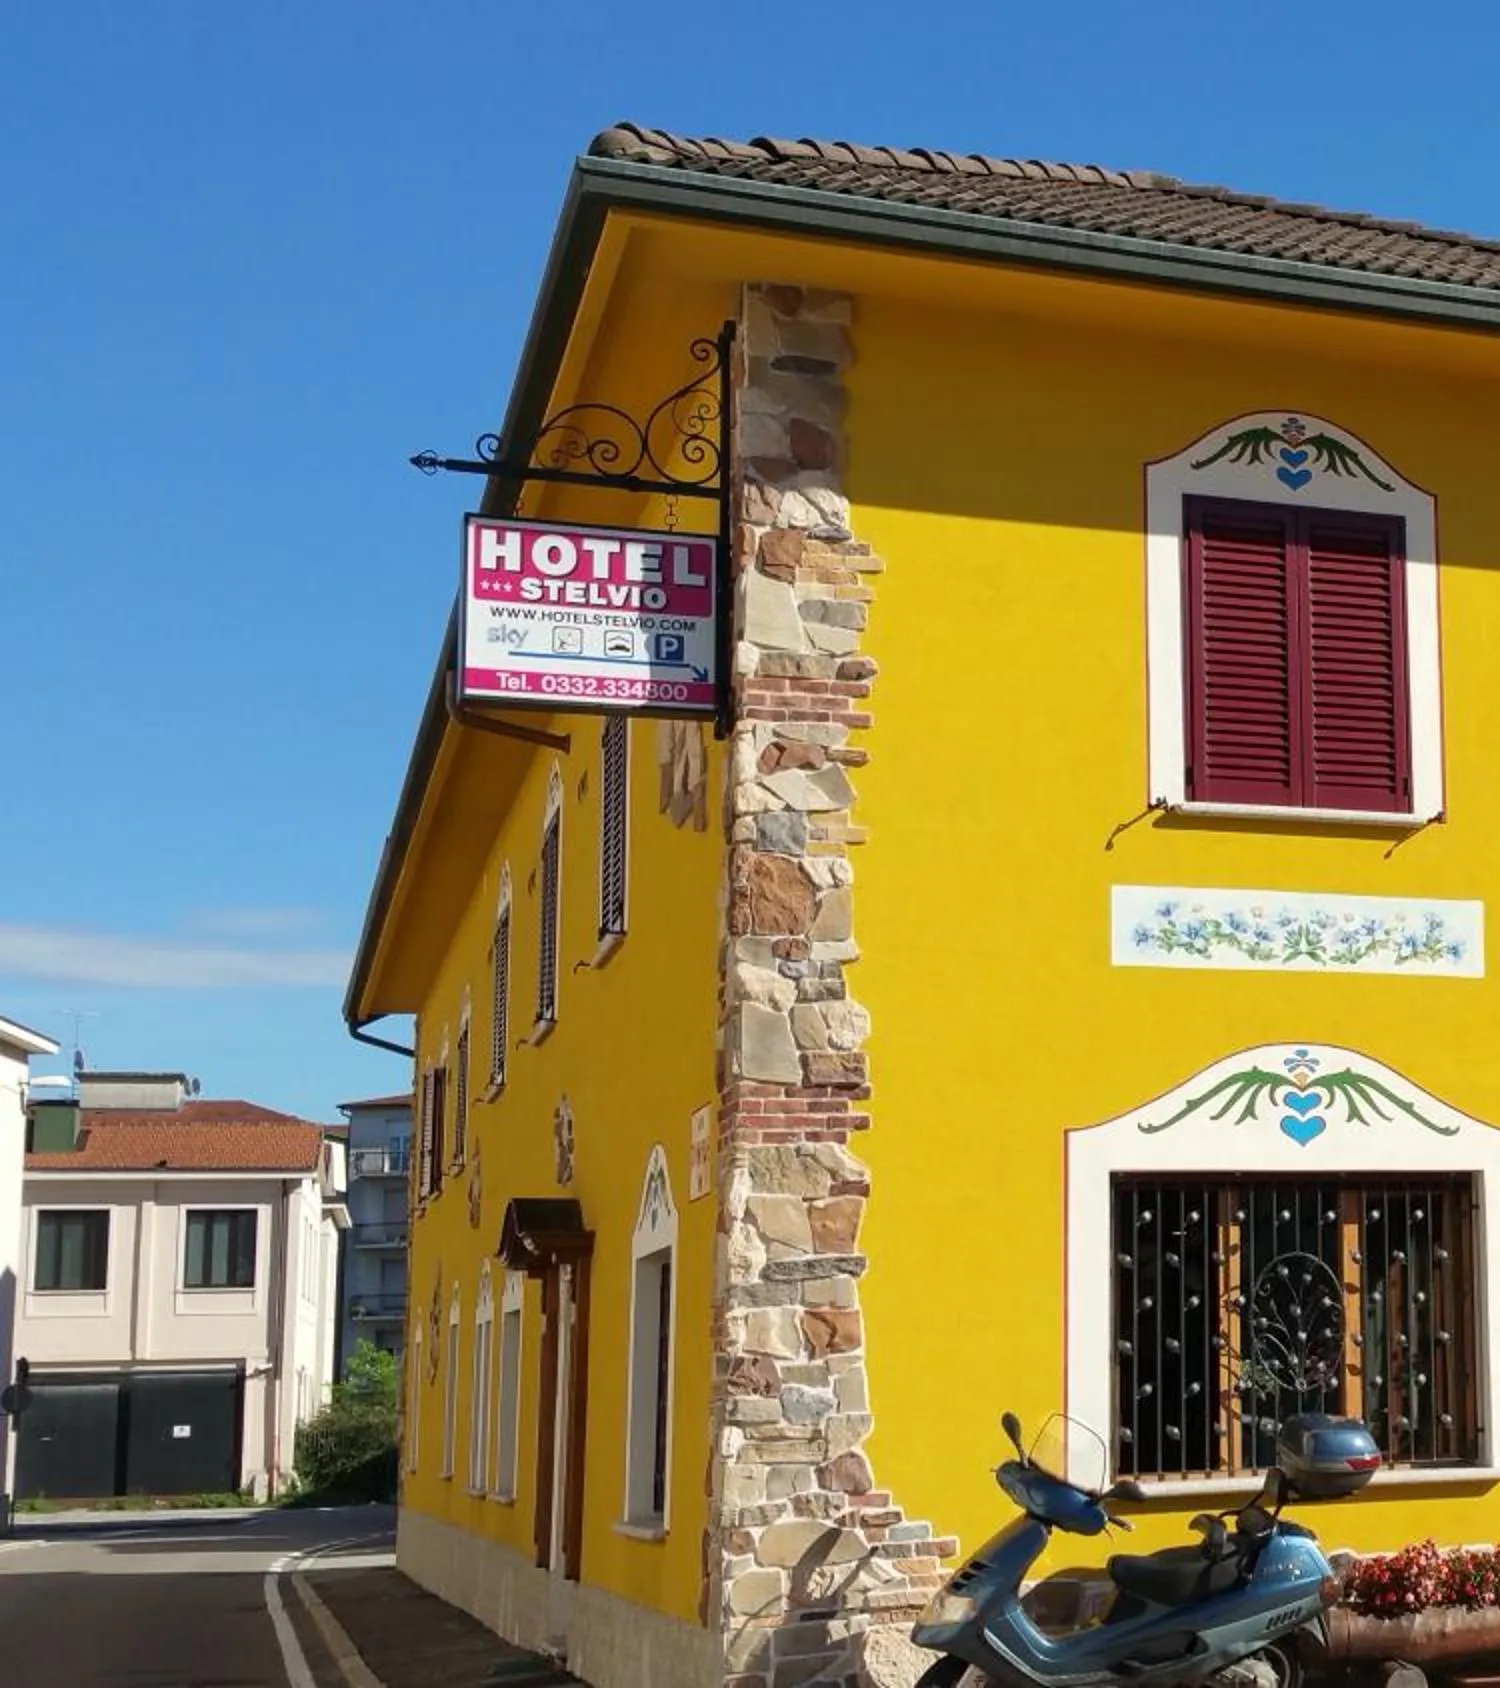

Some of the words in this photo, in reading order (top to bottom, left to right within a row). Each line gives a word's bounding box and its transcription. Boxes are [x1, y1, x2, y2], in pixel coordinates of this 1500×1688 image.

[480, 528, 705, 587] HOTEL
[520, 577, 667, 609] STELVIO
[489, 606, 697, 631] WWW.HOTELSTELVIO.COM
[487, 624, 529, 648] sky
[660, 636, 680, 659] P
[496, 671, 533, 691] Tel.
[541, 674, 687, 700] 0332.334800
